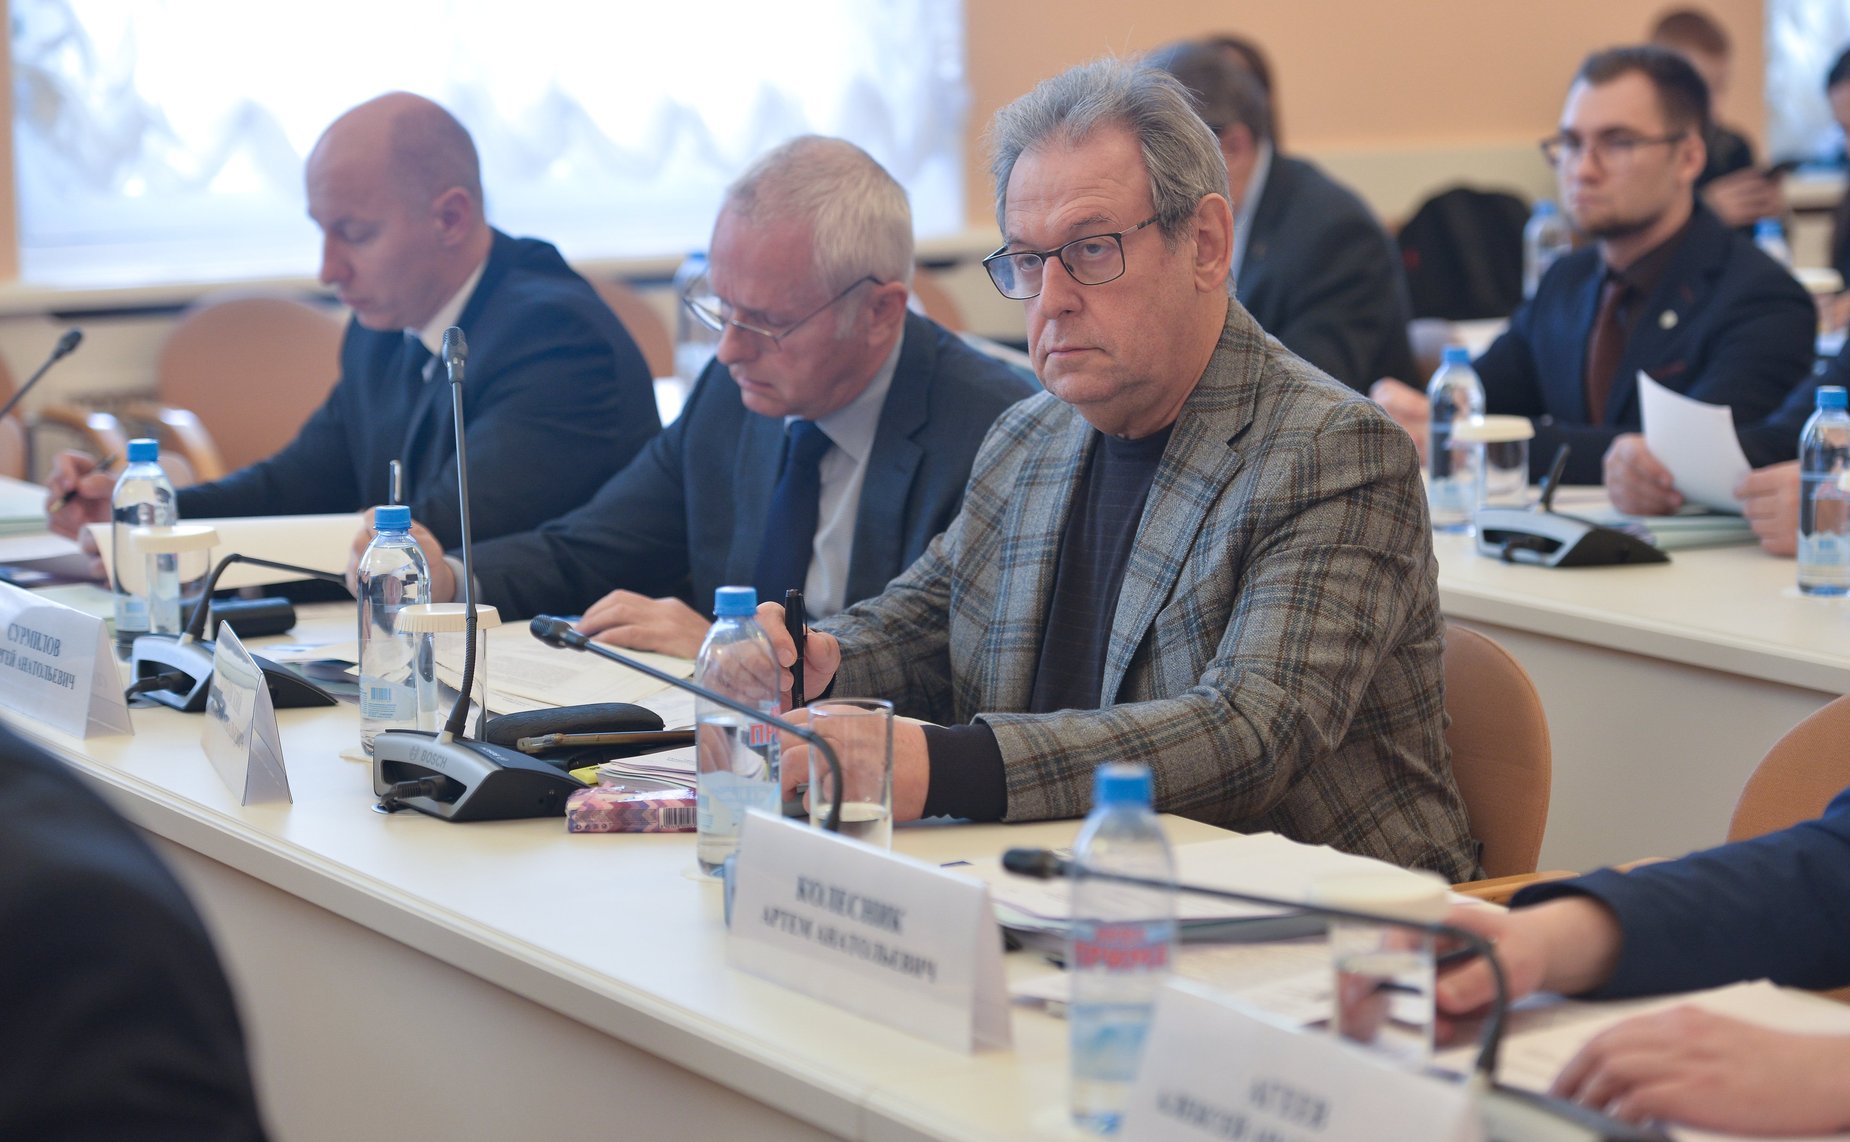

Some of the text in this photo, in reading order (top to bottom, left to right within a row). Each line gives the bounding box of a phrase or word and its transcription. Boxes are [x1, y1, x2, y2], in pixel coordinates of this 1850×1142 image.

[17, 656, 76, 690] АНАТОЛЬЕВИЧ
[421, 750, 448, 769] BOSCH
[795, 875, 907, 936] КОЛЕСНИК
[762, 905, 939, 985] АРТЕМ АНАТОЛЬЕВИЧ
